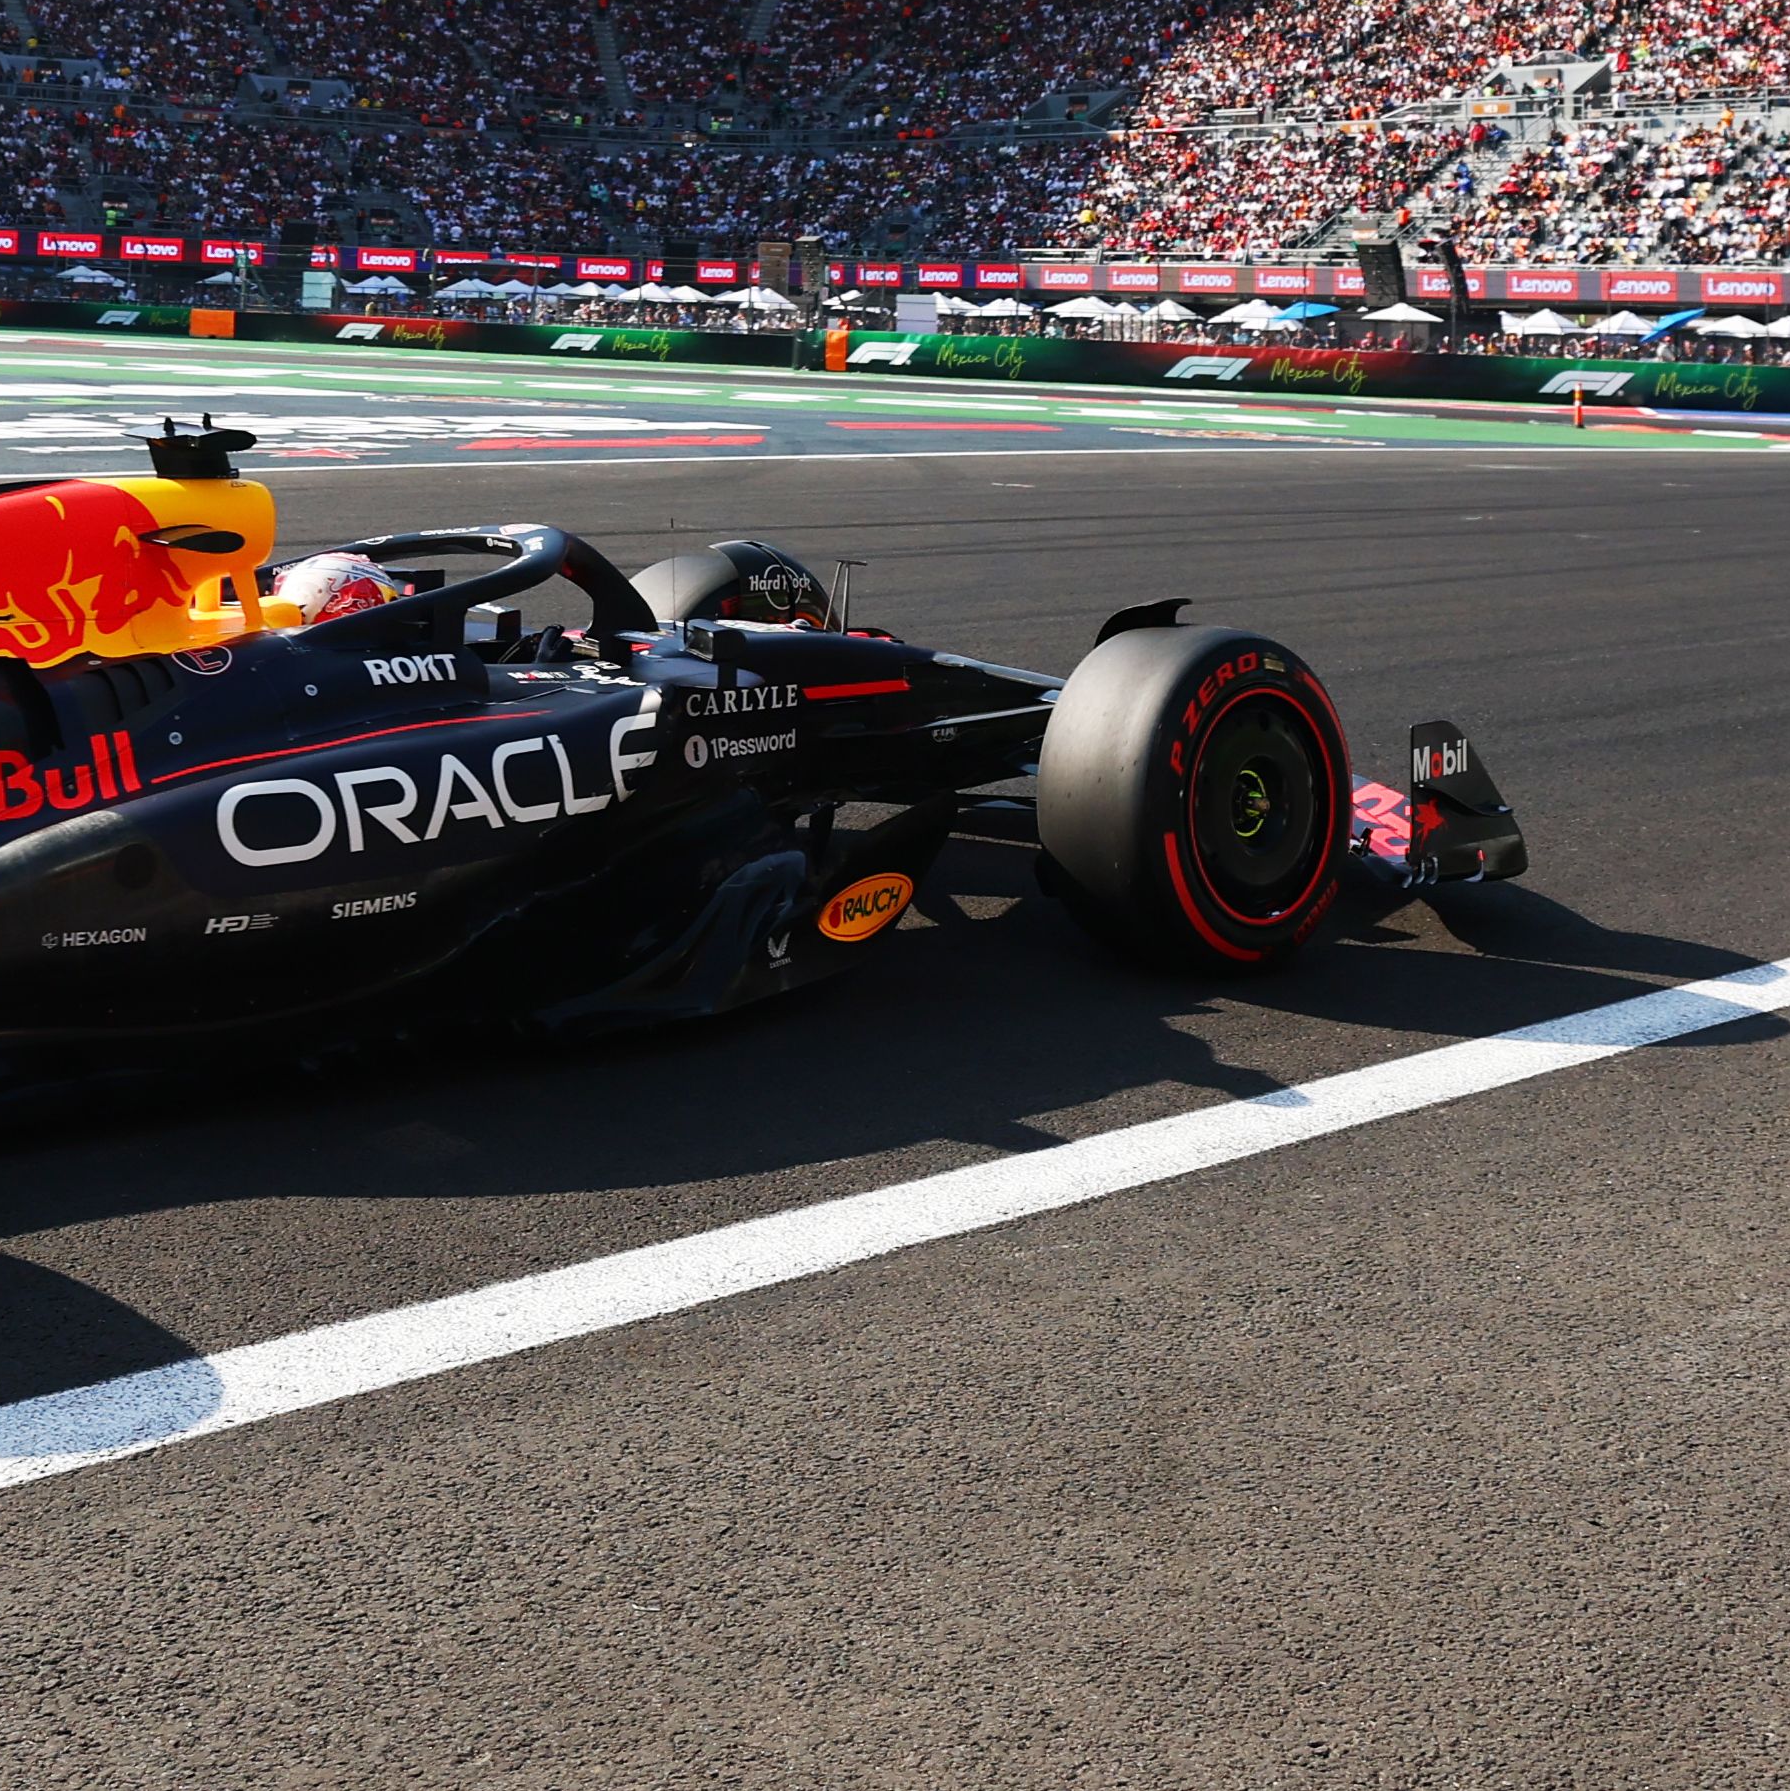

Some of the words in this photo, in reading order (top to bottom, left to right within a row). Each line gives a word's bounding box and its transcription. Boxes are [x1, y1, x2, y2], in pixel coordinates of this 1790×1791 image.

[207, 244, 257, 260] Leno
[362, 252, 411, 267] Lenovo
[581, 262, 627, 276] Lenovo
[700, 266, 734, 279] Lenovo
[919, 268, 958, 282] Lenovo
[1044, 269, 1089, 285] Lenovo
[1112, 270, 1159, 286] Lenovo
[1183, 271, 1232, 287] Lenovo
[1258, 272, 1309, 289] Lenovo
[1338, 273, 1365, 290] Len
[1421, 274, 1480, 293] Leno
[1511, 276, 1573, 294] Lenovo
[1707, 279, 1776, 297] Lenovo
[96, 310, 141, 326] F1
[335, 322, 385, 340] F1
[550, 333, 604, 351] F1
[847, 341, 921, 366] F1
[935, 343, 991, 368] Mexico
[994, 338, 1027, 378] City
[1164, 355, 1253, 381] F1
[1270, 355, 1330, 384] Mexico
[1332, 351, 1369, 394] City
[1538, 370, 1635, 396] F1
[1654, 372, 1720, 400] Mexico
[1724, 367, 1763, 410] City
[749, 574, 781, 592] Hard
[362, 653, 457, 686] ROKT
[685, 683, 799, 718] CARLYLE
[1170, 740, 1184, 777] P
[1182, 651, 1258, 736] ZERO
[710, 728, 797, 760] 1Password
[1413, 739, 1469, 784] Mobil
[216, 709, 660, 868] ORACLE
[331, 891, 418, 919] SIEMENS
[841, 883, 902, 923] RAUCH
[62, 927, 146, 948] HEXAGON
